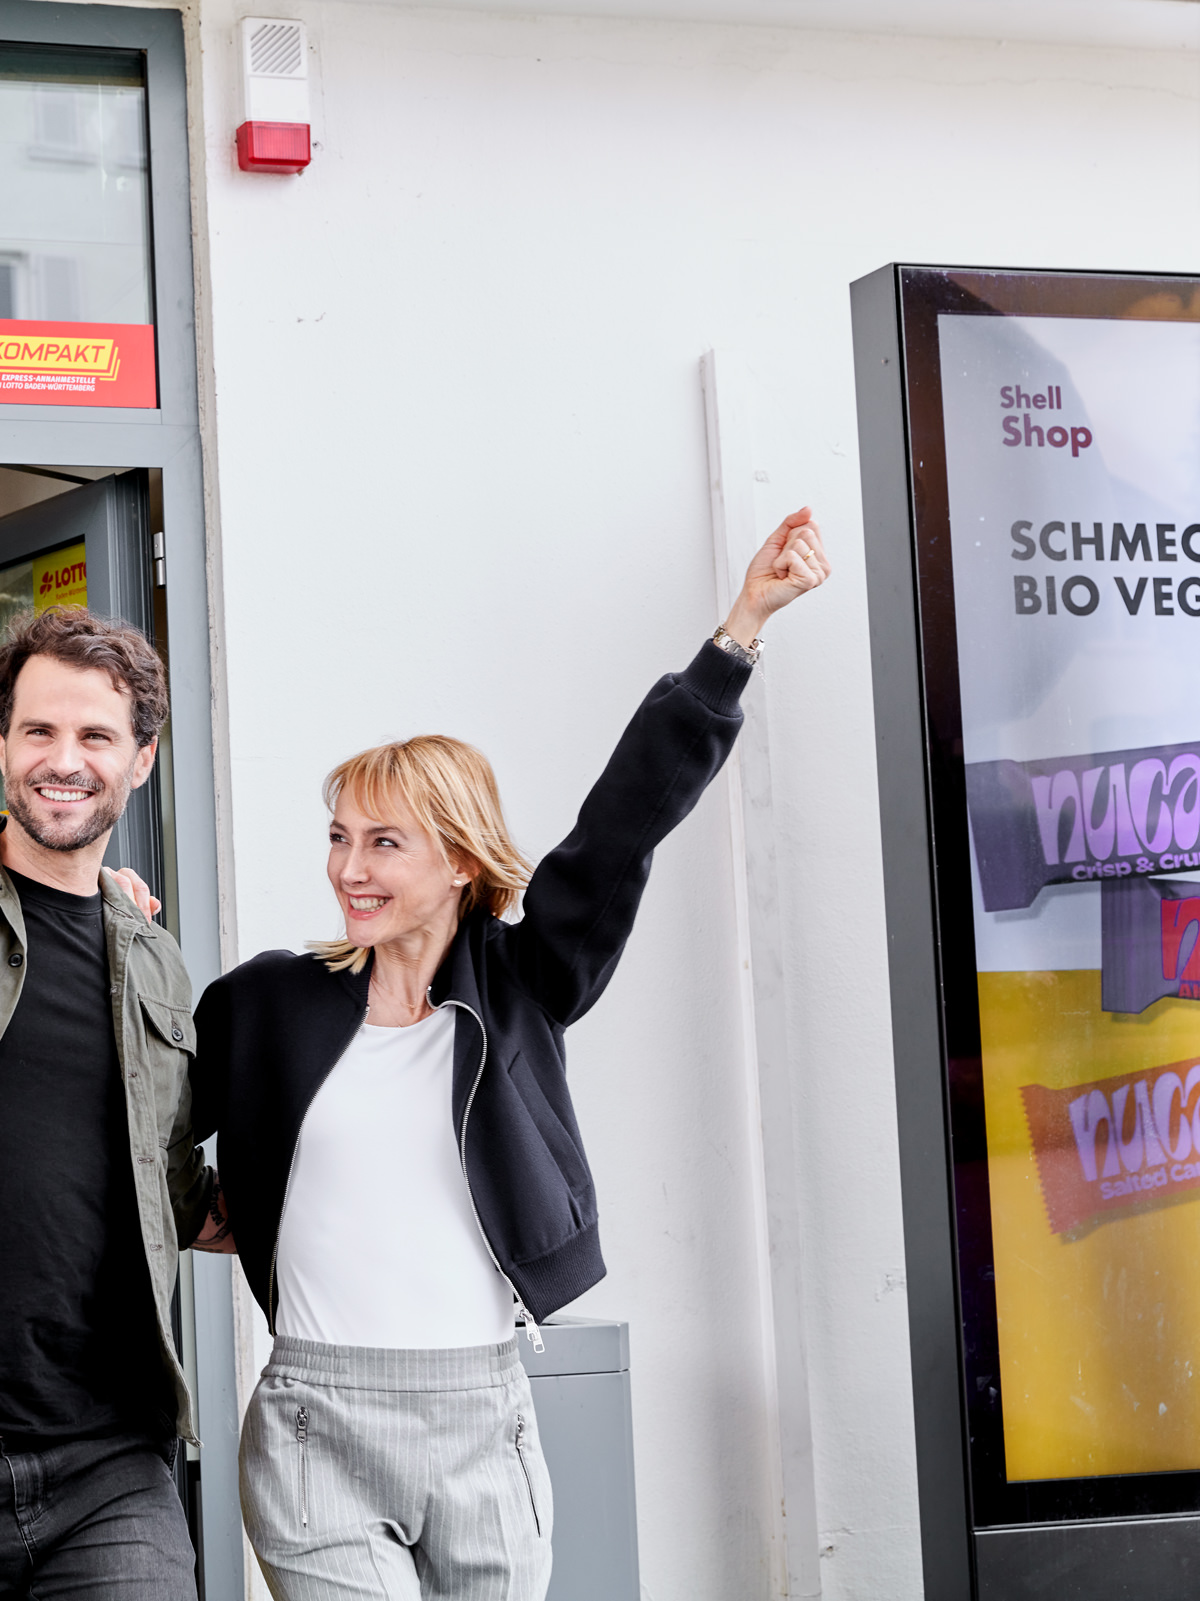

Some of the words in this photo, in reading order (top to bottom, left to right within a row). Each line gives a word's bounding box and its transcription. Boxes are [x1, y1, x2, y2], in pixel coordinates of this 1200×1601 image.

[1, 374, 96, 384] EXPRESS-ANNAHMESTELLE
[24, 382, 95, 392] BADEN-WÜRTTEMBERG
[1000, 384, 1062, 410] Shell
[1002, 413, 1093, 457] Shop
[1014, 575, 1100, 616] BIO
[1072, 860, 1132, 881] Crisp
[1135, 856, 1155, 873] &
[1159, 852, 1200, 870] Cru
[1179, 984, 1200, 999] Al
